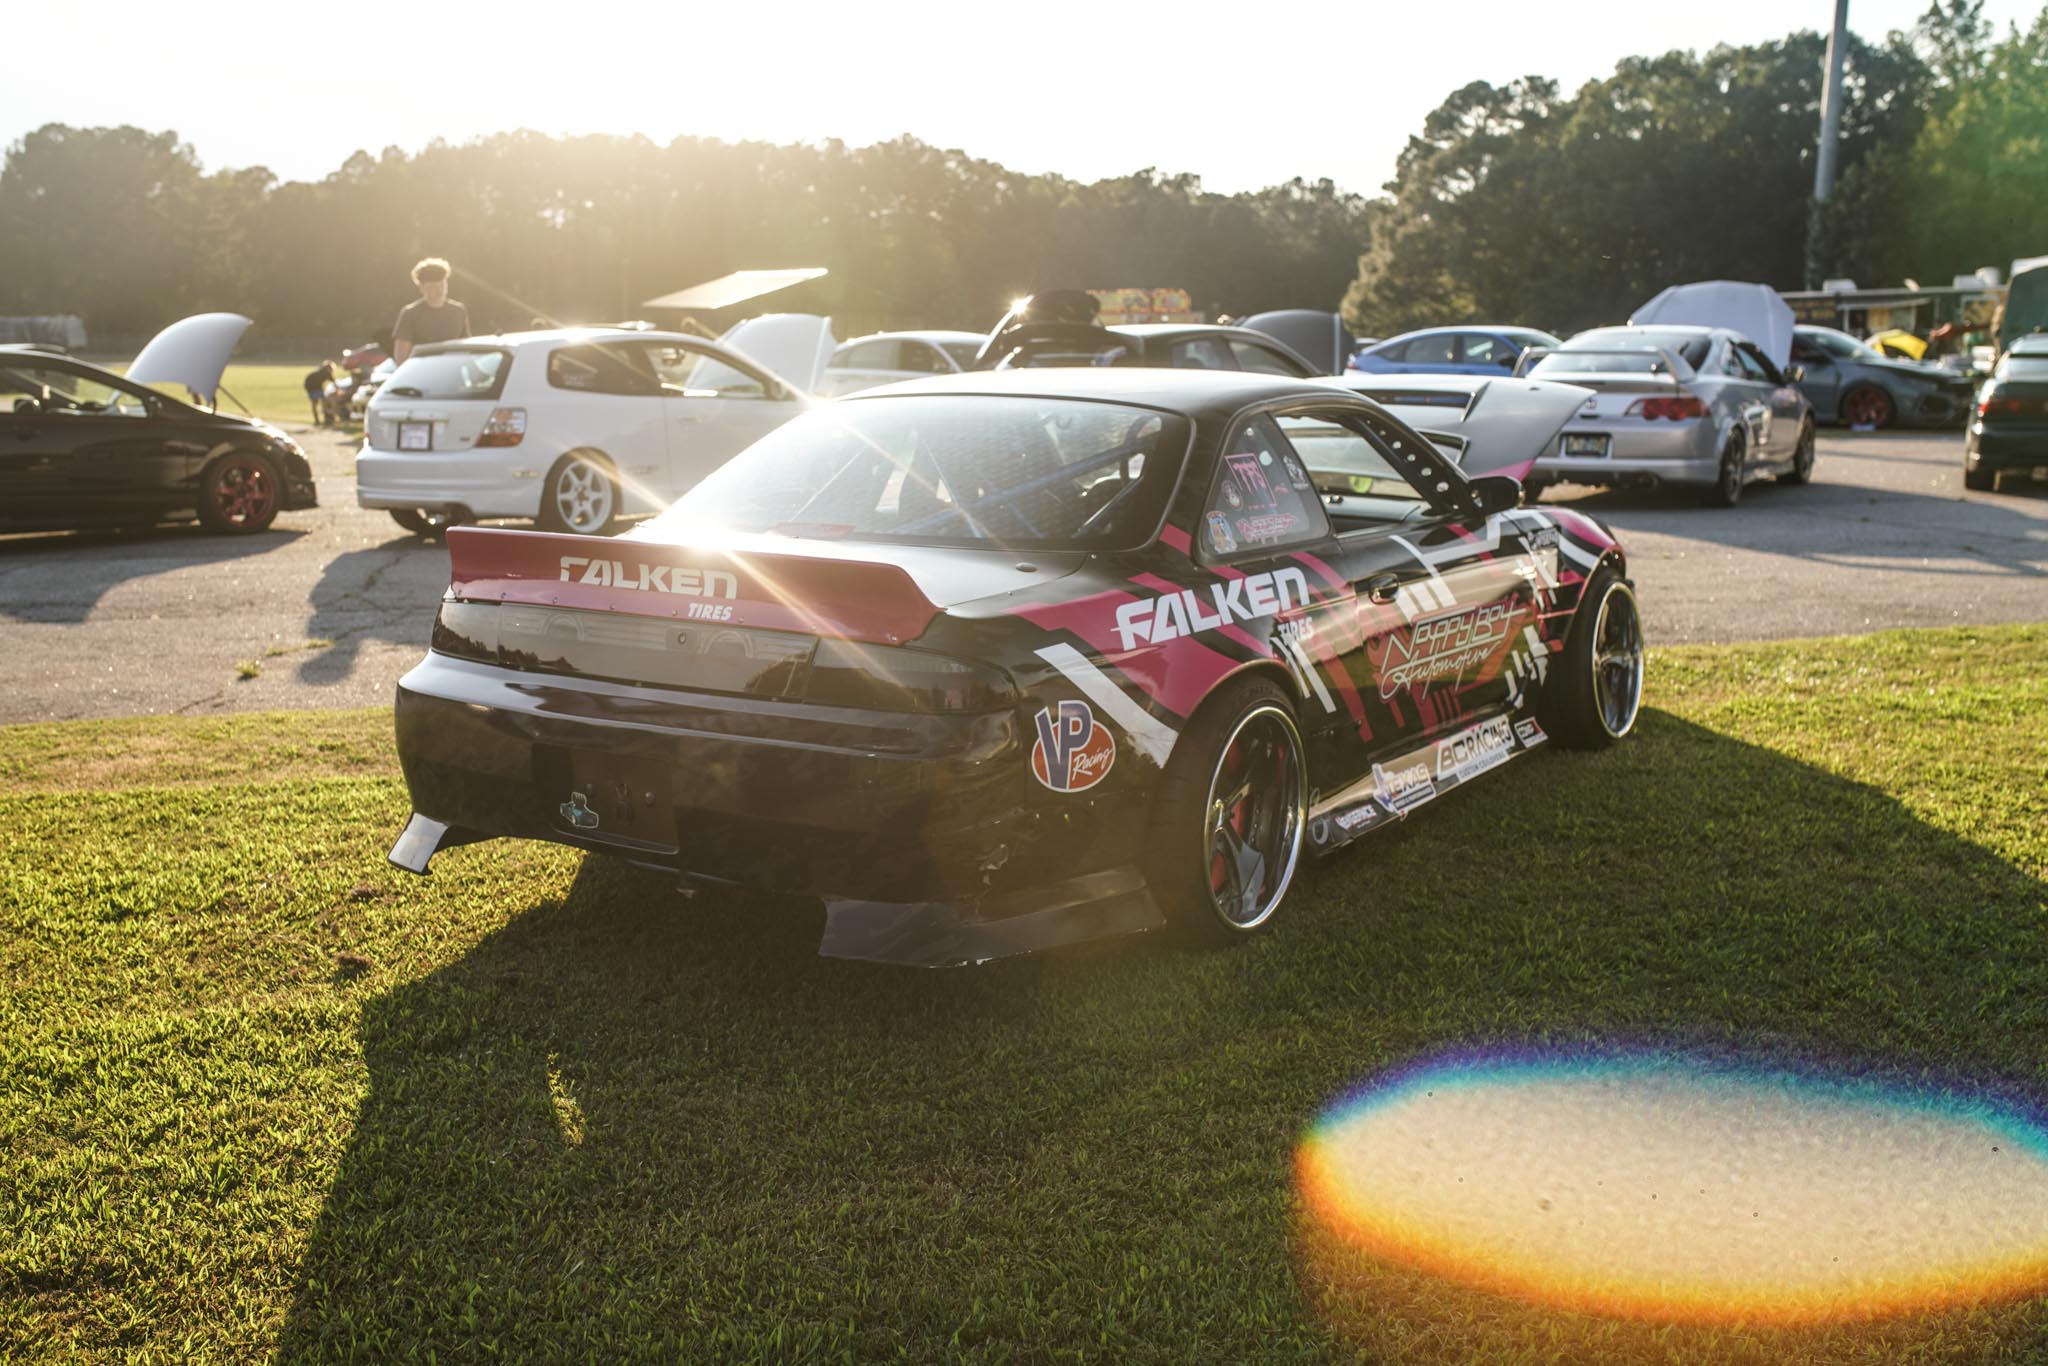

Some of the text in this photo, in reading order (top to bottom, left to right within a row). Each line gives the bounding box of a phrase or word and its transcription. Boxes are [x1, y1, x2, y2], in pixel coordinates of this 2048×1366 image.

[560, 556, 737, 600] FALKEN
[688, 603, 733, 621] TIRES
[1110, 567, 1310, 651] FALKEN
[1277, 616, 1313, 646] TIRES
[1034, 700, 1093, 792] VP
[1072, 746, 1113, 781] Racing
